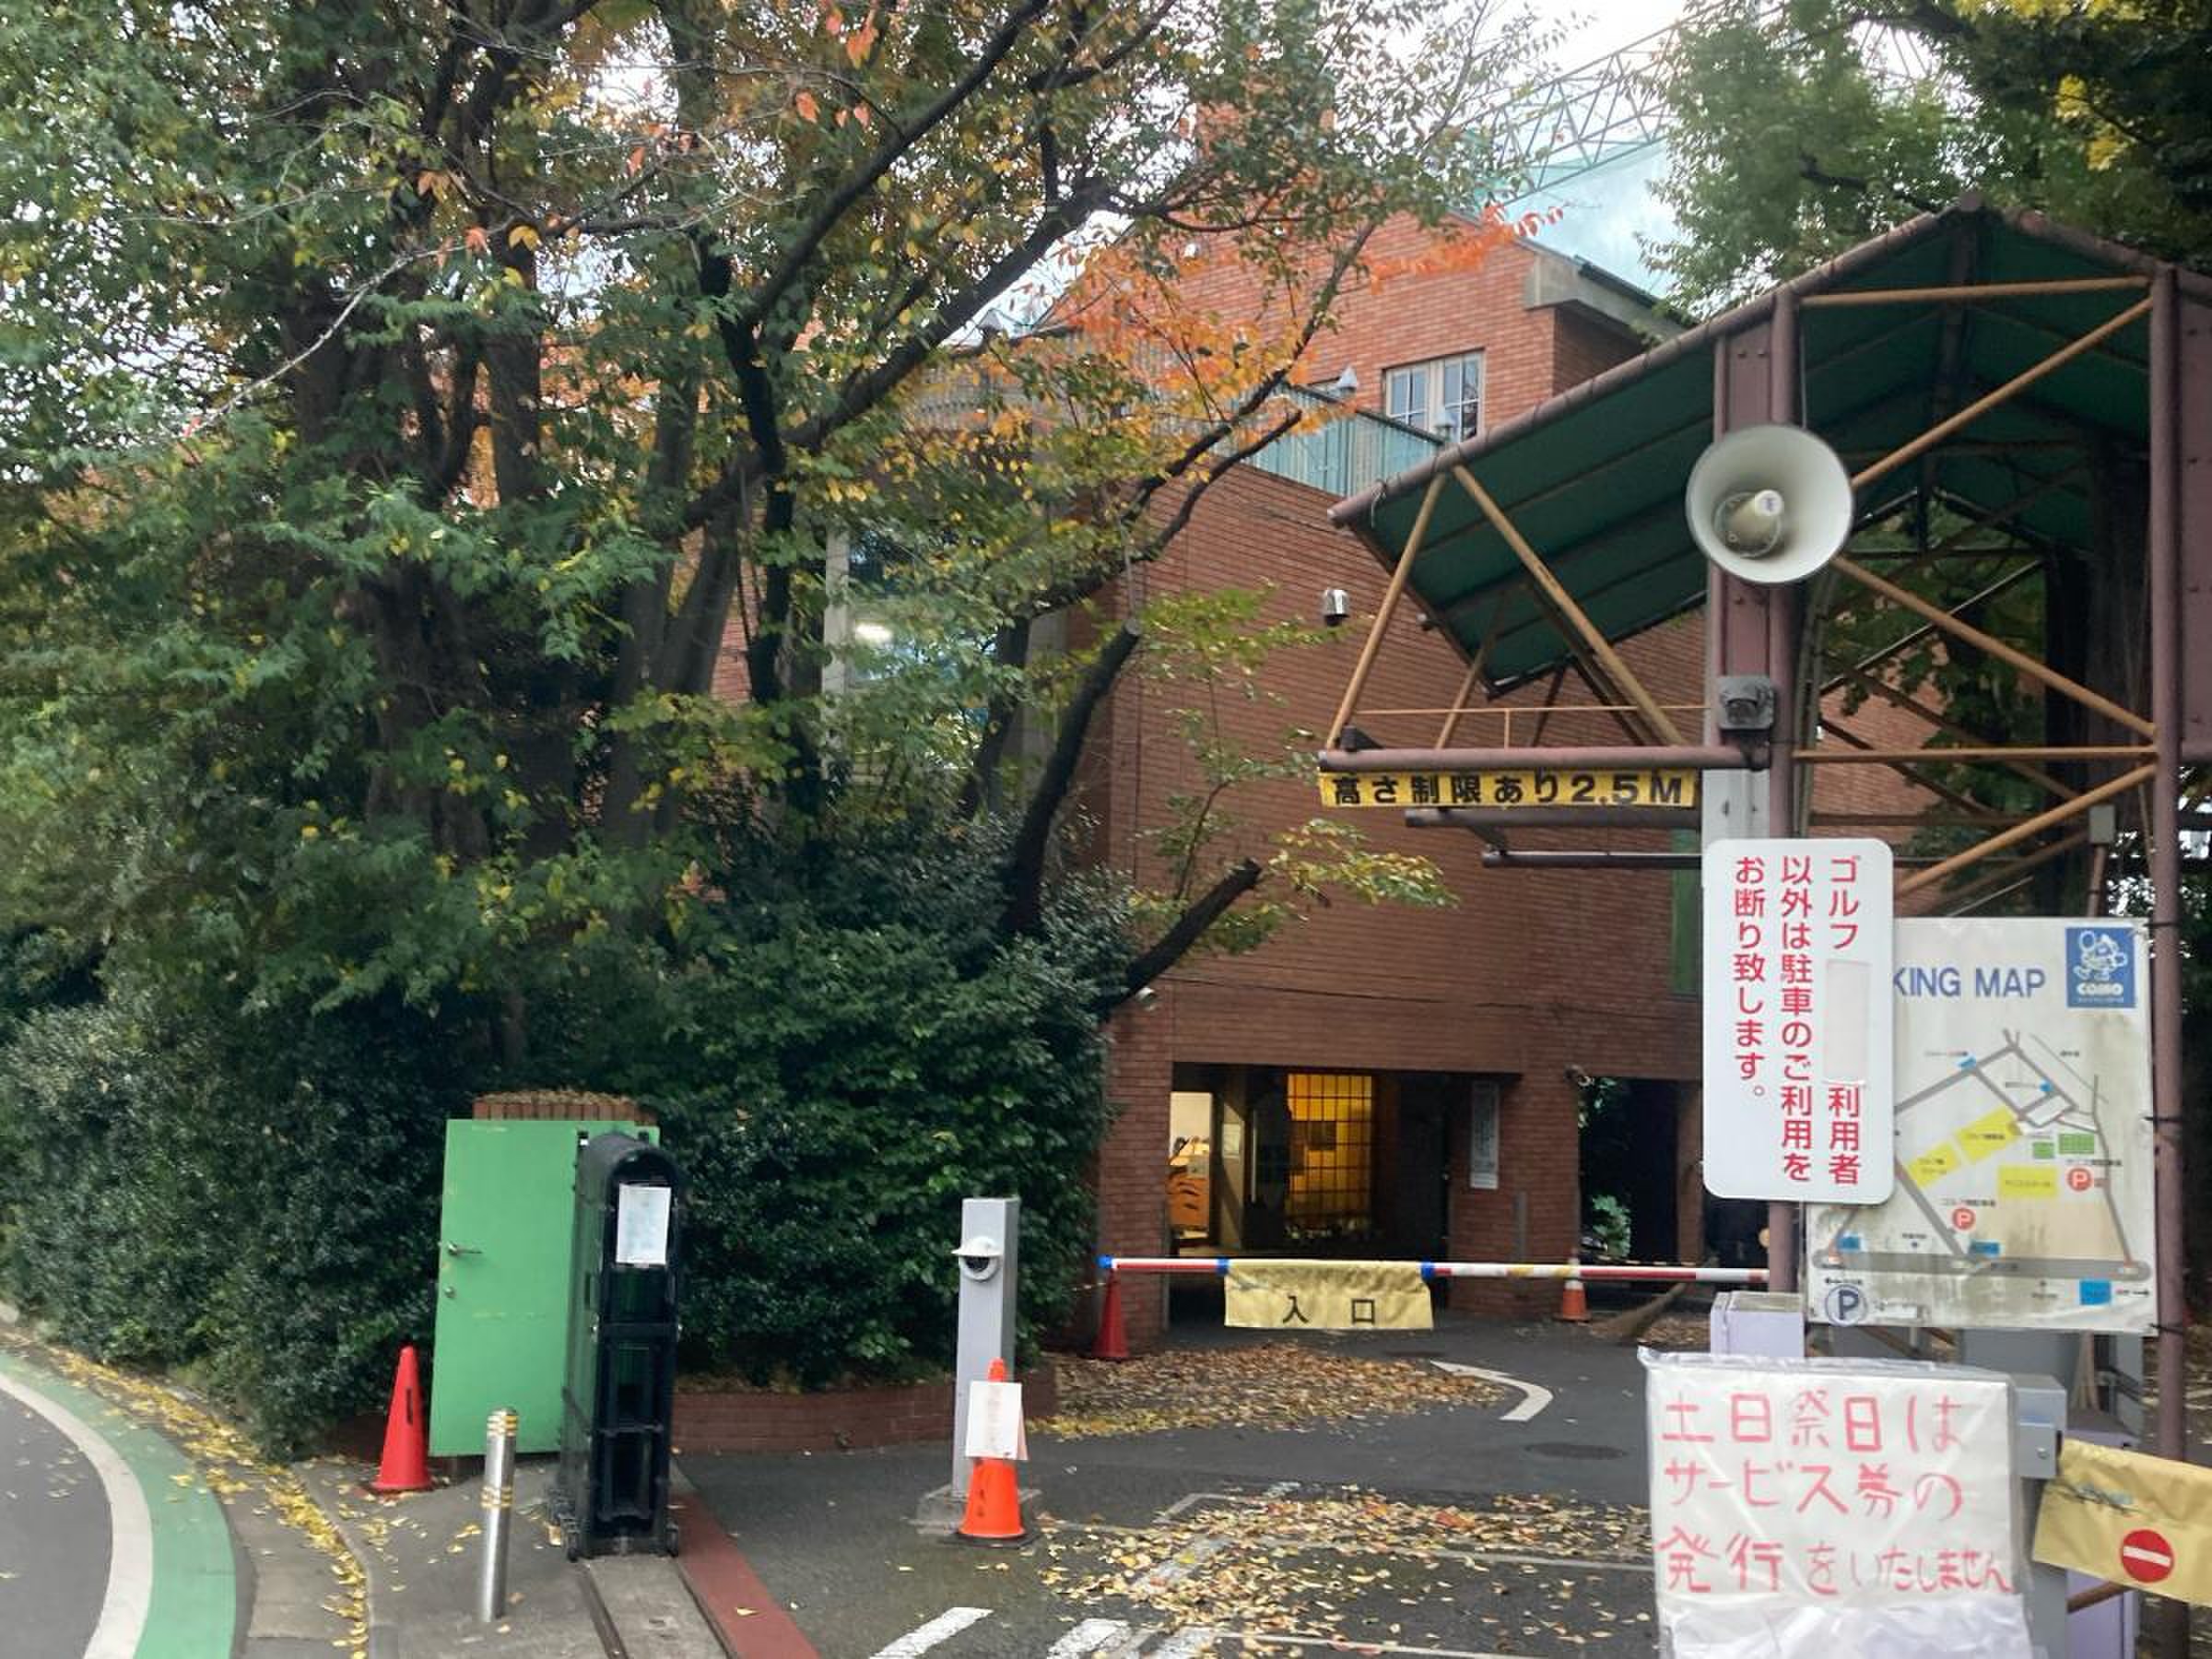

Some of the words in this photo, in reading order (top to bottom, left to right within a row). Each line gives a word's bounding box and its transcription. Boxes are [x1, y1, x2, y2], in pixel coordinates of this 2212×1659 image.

[1333, 767, 1682, 806] 高さ制限あり2.5M
[1828, 854, 1860, 949] ゴルフ
[1733, 856, 1766, 1097] お断り致します。
[1975, 968, 2047, 998] MAP
[1780, 854, 1813, 1182] 以外は駐車のご利用を
[1827, 1086, 1861, 1185] 利用者
[1282, 1295, 1376, 1324] 入口
[1838, 1289, 1859, 1320] P
[1662, 1389, 1964, 1453] 土日祭日は
[1663, 1458, 1964, 1522] サービス券の
[1657, 1524, 2017, 1596] 発行をいたしません
